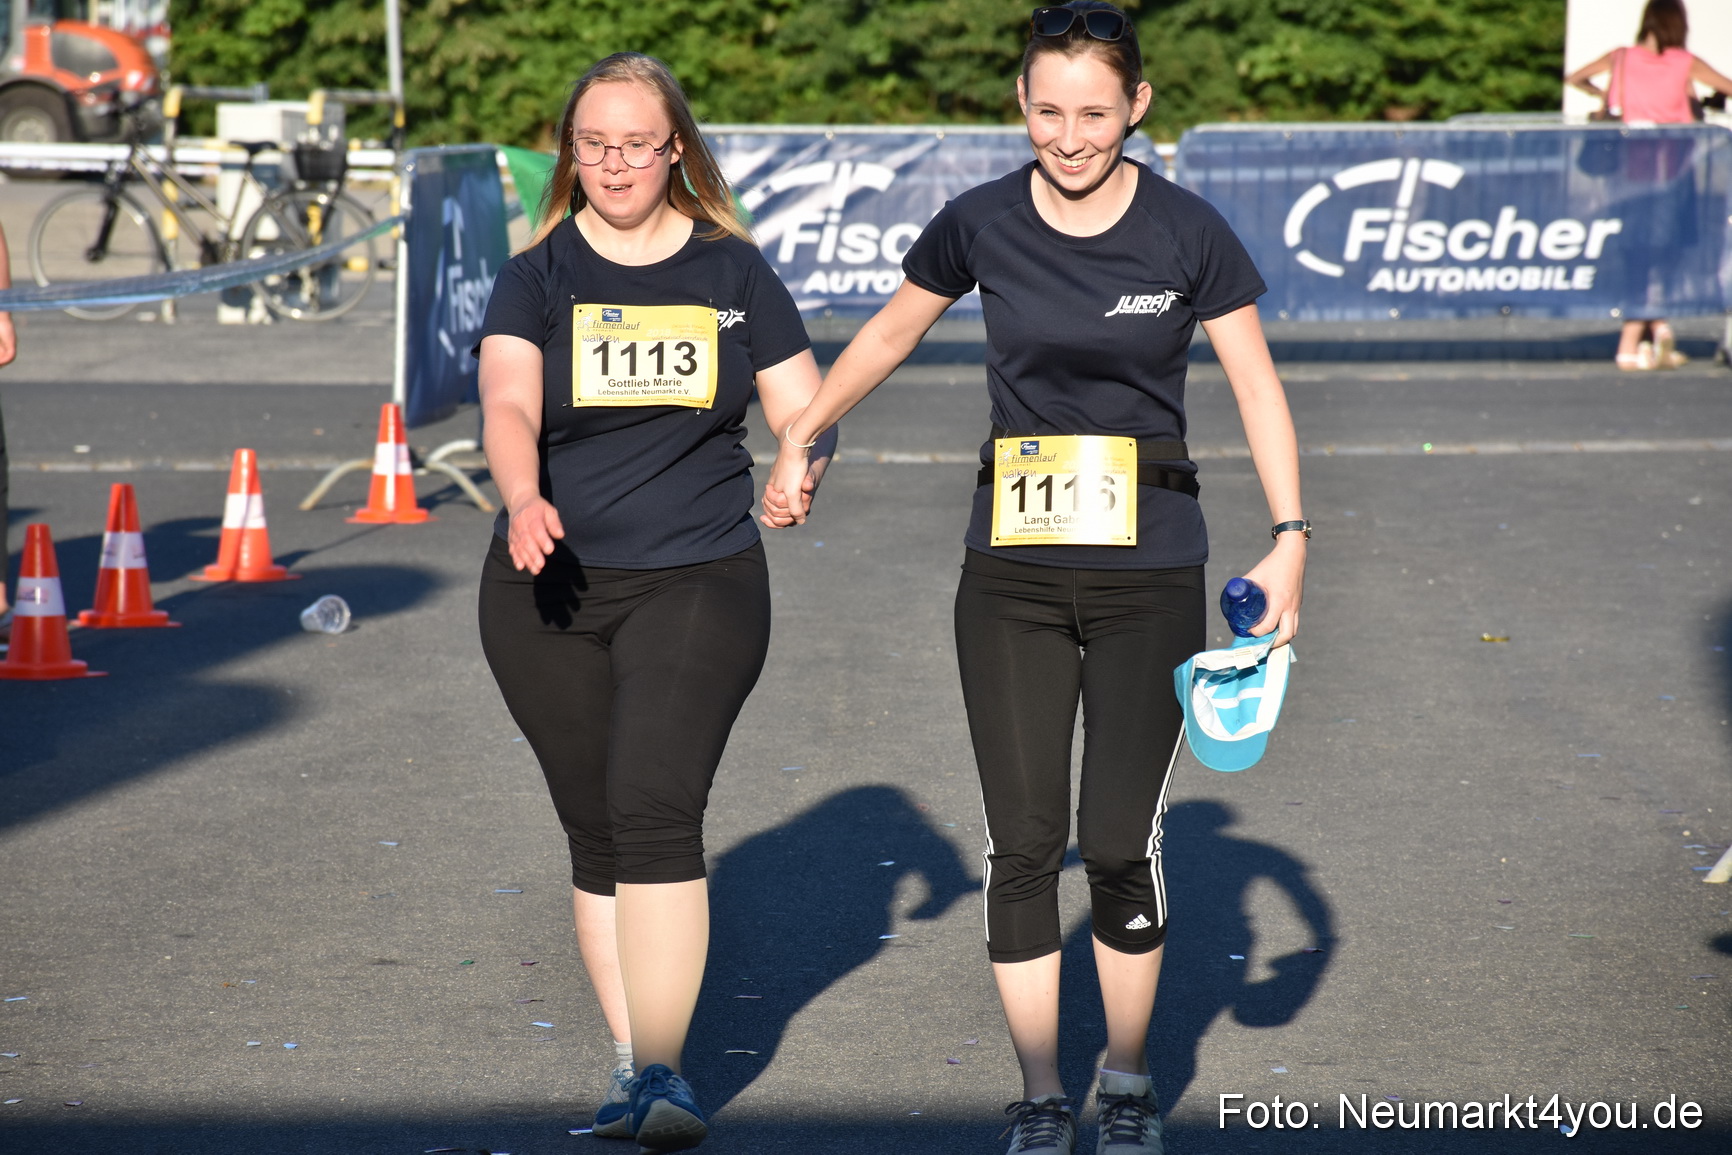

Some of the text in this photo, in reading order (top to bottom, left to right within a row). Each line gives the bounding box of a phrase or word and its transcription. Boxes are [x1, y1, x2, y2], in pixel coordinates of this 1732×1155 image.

[777, 209, 930, 265] Fisc
[1343, 206, 1623, 262] Fischer
[1367, 265, 1597, 292] AUTOMOBILE
[1104, 294, 1166, 317] JURA
[592, 320, 641, 330] firmenlauf
[592, 341, 698, 376] 1113
[607, 378, 682, 388] Gottlieb Marie
[1011, 453, 1058, 463] firmenlauf
[1024, 515, 1050, 526] Lang
[1014, 526, 1055, 534] Lebenshilfe
[1125, 921, 1152, 930] adidas
